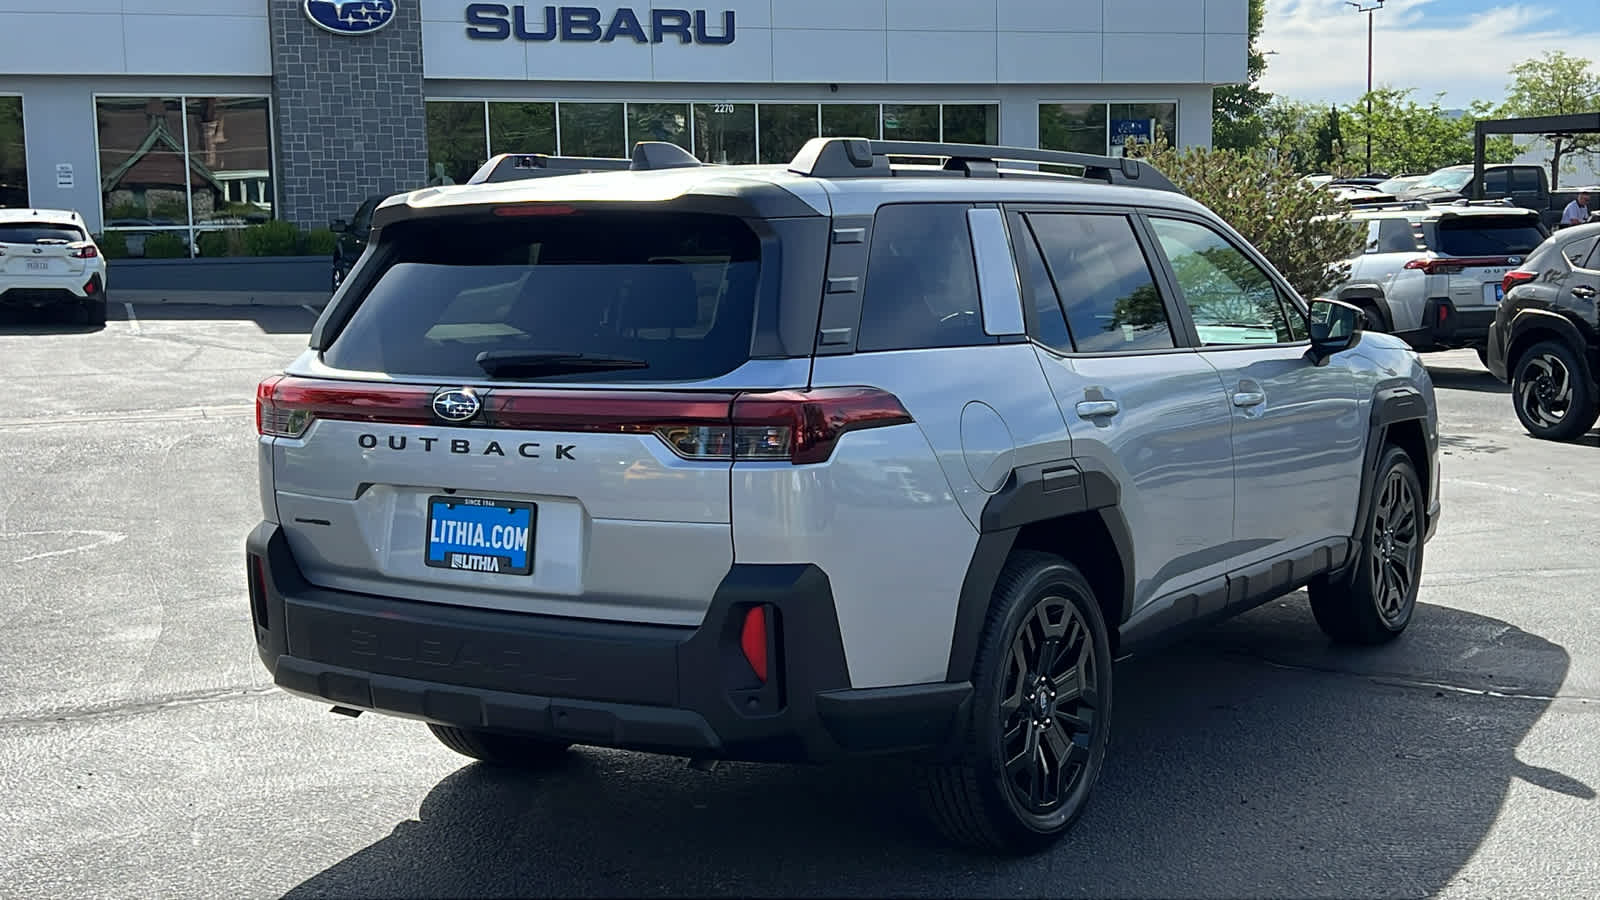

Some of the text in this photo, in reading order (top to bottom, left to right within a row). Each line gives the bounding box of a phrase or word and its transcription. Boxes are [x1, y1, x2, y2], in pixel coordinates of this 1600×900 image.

[465, 3, 736, 45] SUBARU
[714, 104, 734, 113] 2270
[358, 433, 577, 461] OUTBACK
[430, 518, 529, 552] LITHIA.COM
[462, 554, 499, 572] LITHIA
